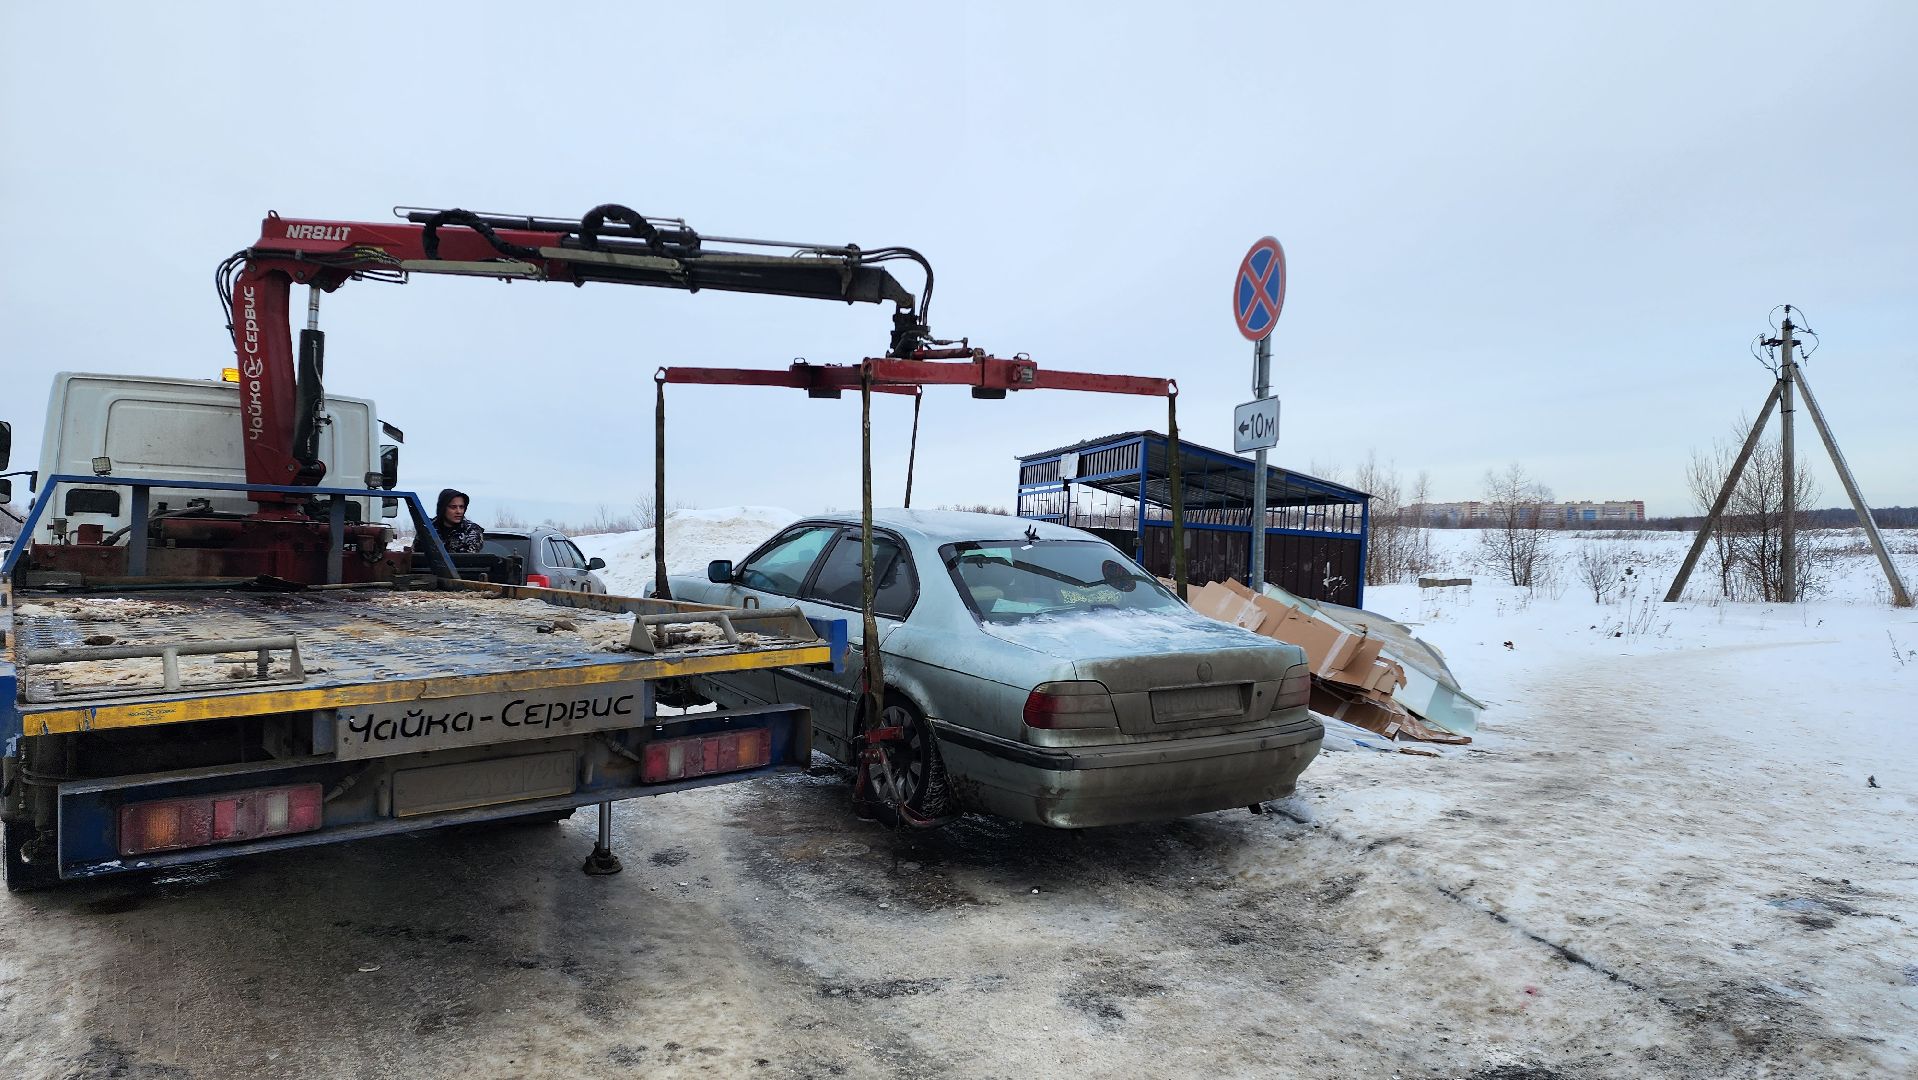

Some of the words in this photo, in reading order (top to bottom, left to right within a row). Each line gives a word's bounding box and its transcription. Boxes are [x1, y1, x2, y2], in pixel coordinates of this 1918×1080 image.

[286, 224, 351, 241] NR811T
[243, 285, 260, 354] Сервис
[247, 380, 263, 440] Чайка
